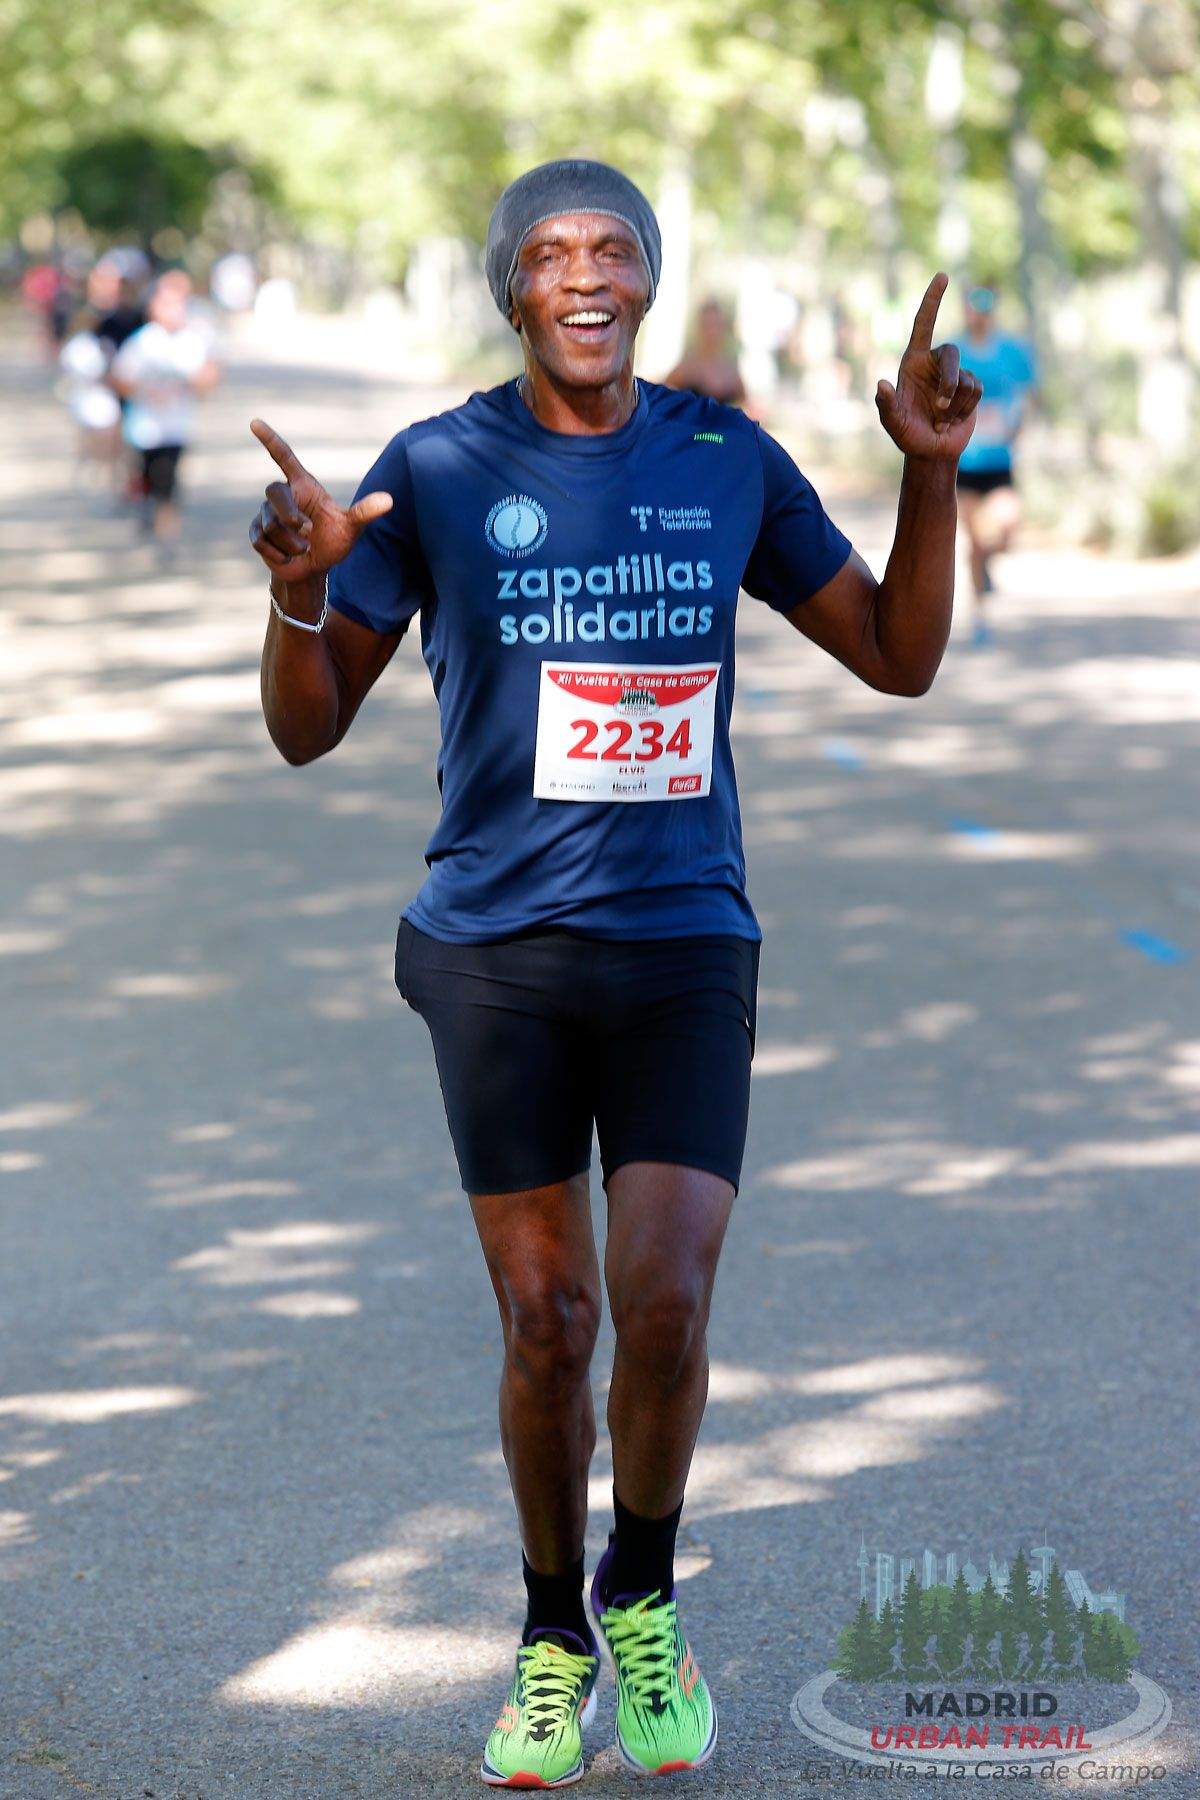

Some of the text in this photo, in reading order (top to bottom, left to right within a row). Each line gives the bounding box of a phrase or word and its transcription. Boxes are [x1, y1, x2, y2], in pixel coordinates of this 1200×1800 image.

[497, 552, 713, 606] zapatillas
[500, 598, 714, 645] solidarias
[575, 673, 609, 687] Vuelta
[636, 677, 663, 688] Casa
[665, 676, 677, 688] de
[679, 674, 709, 688] Campo
[566, 718, 692, 761] 2234
[618, 766, 646, 775] ELVIS
